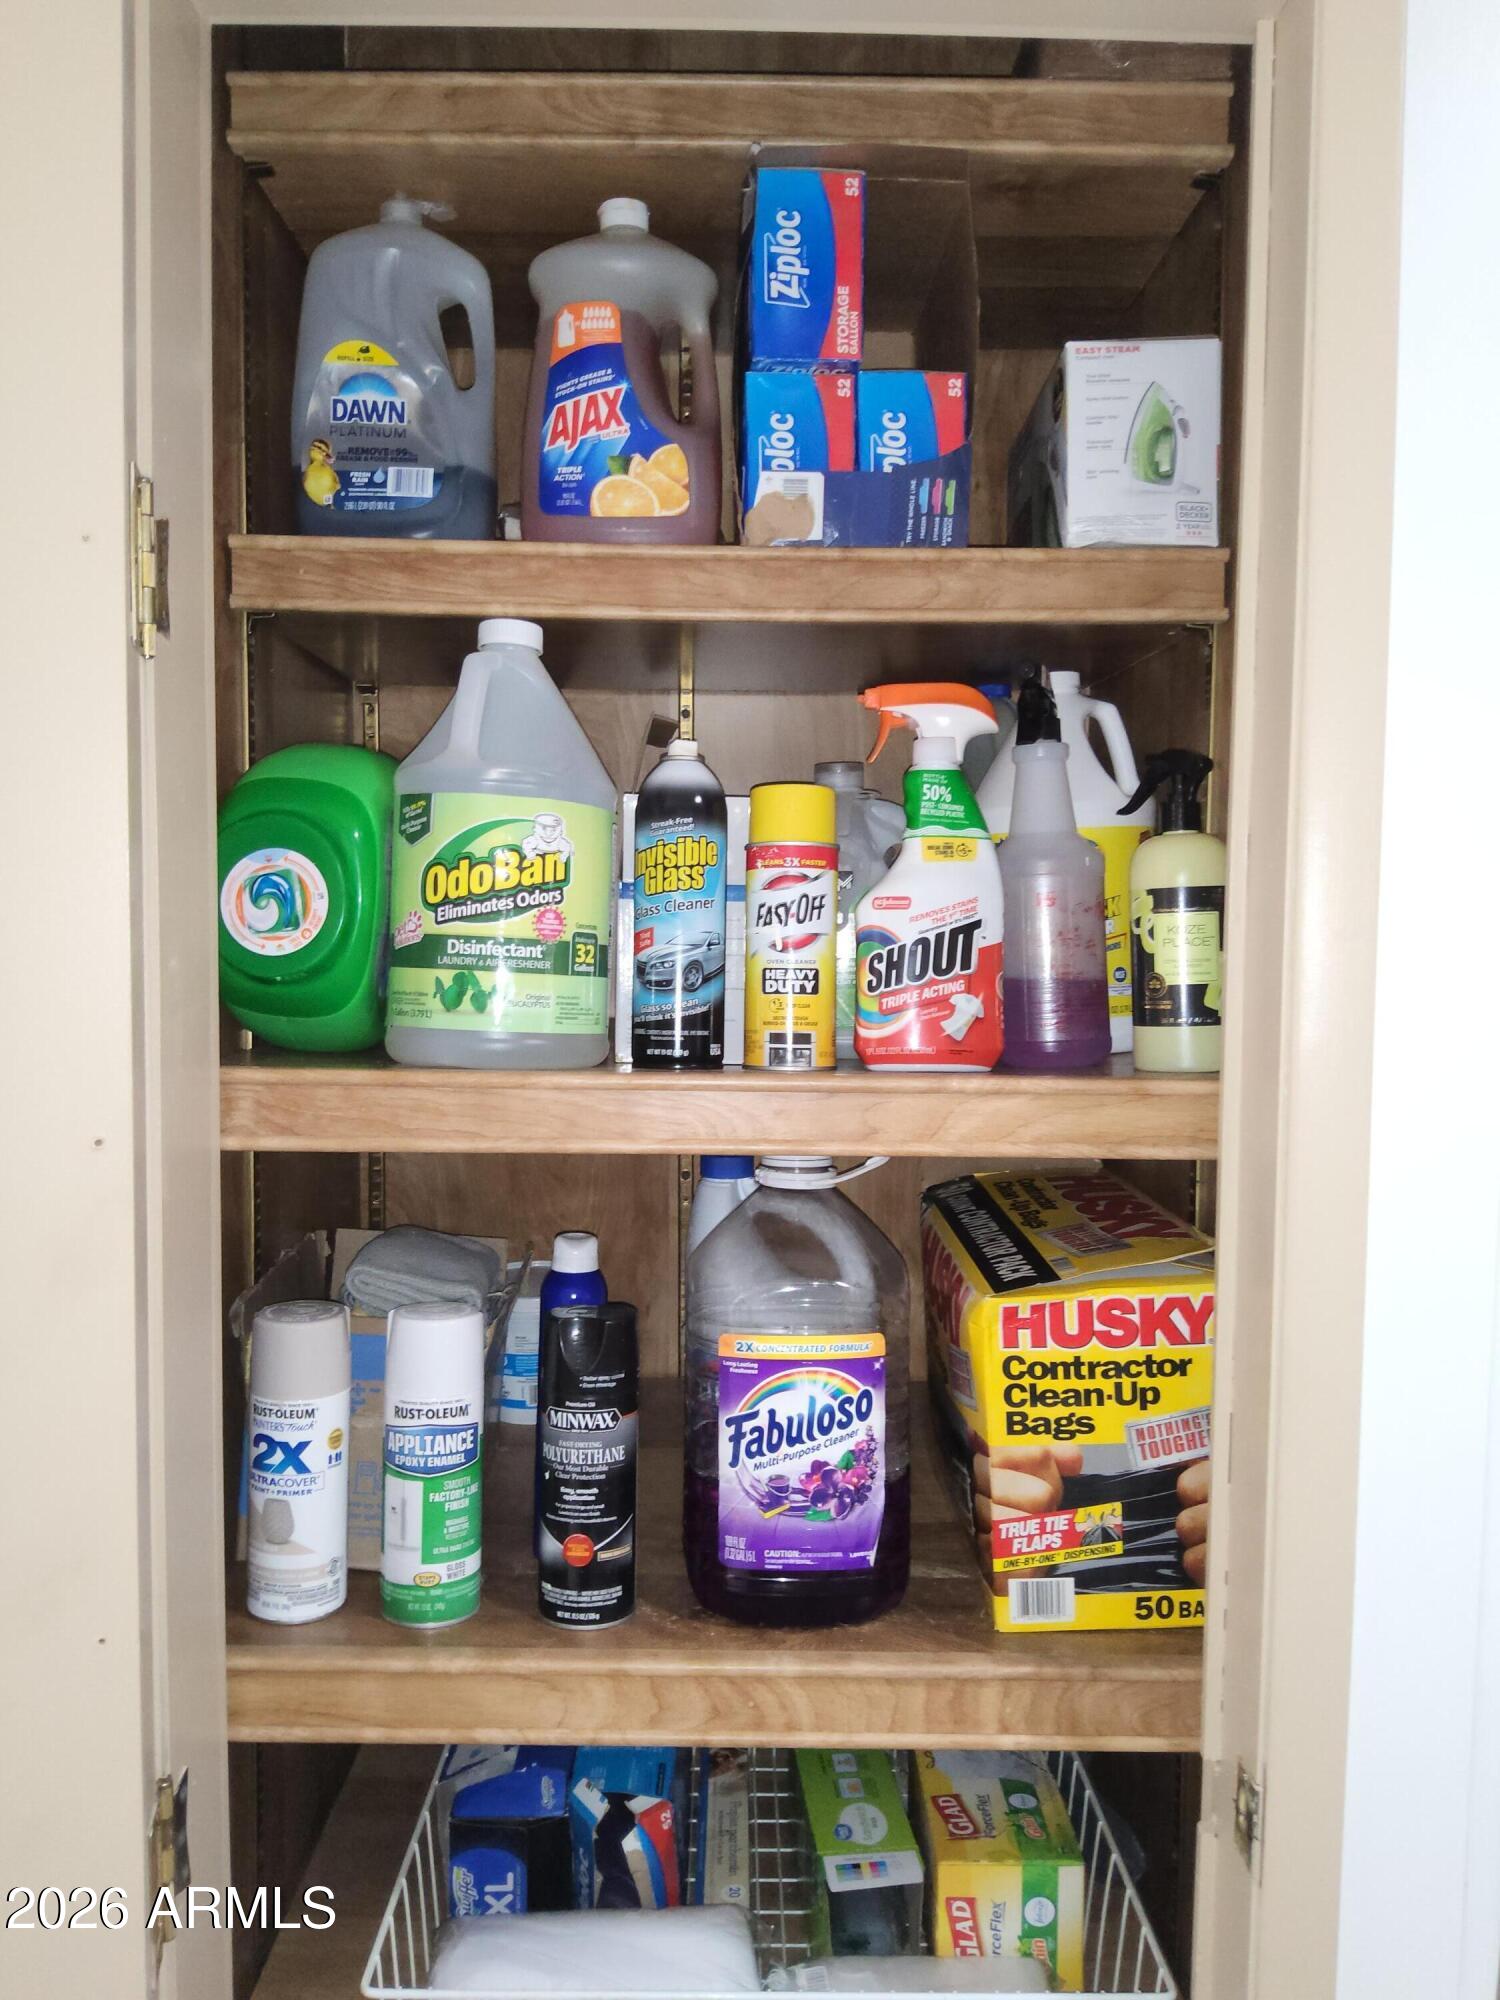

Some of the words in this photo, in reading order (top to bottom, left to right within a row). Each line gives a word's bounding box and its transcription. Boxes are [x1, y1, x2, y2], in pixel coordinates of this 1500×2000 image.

[845, 177, 860, 197] 52
[769, 209, 810, 299] Ziploc
[837, 285, 850, 354] STORAGE
[849, 311, 859, 355] GALLON
[1075, 346, 1102, 355] EASY
[1105, 345, 1141, 354] STEAM
[837, 378, 851, 398] 52
[948, 378, 962, 397] 52
[332, 398, 406, 424] DAWN
[547, 388, 626, 450] AJAX
[329, 426, 407, 439] PLATINUM
[602, 428, 630, 439] ULTRA
[764, 413, 795, 471] ploc
[876, 411, 907, 472] ploc
[557, 465, 582, 474] TRIPLE
[922, 783, 952, 803] 50%
[783, 856, 801, 867] 3X
[425, 848, 566, 905] OdoBan
[644, 864, 705, 896] Glass
[436, 896, 515, 922] Eliminates
[516, 889, 562, 908] Odors
[664, 898, 716, 913] Cleaner
[446, 938, 544, 959] Disinfectant
[575, 943, 595, 964] 32
[867, 918, 983, 994] SHOUT
[437, 955, 477, 966] LAUNDRY
[764, 969, 817, 980] HEAVY
[764, 980, 816, 993] DUTY
[881, 990, 921, 1010] TRIPLE
[921, 980, 966, 1000] ACTING
[957, 1210, 1019, 1259] CONTRACTOR
[989, 1254, 1038, 1282] PACK
[1001, 1295, 1215, 1350] HUSKY
[735, 1341, 754, 1353] 2X
[756, 1344, 826, 1353] CONCENTRATED
[828, 1342, 870, 1353] FORMULA
[1002, 1353, 1193, 1381] Contractor
[253, 1403, 316, 1420] RUST-OLEUM
[394, 1404, 470, 1420] RUST-OLEUM
[549, 1409, 614, 1430] MINWAX
[724, 1388, 874, 1469] Fabuloso
[1005, 1411, 1096, 1441] Bags
[387, 1428, 475, 1456] APPLIANCE
[752, 1442, 822, 1472] Multi-Purpose
[823, 1427, 861, 1449] Cleaner
[1137, 1430, 1209, 1461] TOUGHE
[252, 1433, 313, 1475] 2X
[394, 1454, 426, 1467] EPOXY
[427, 1453, 467, 1468] ENAMEL
[543, 1442, 626, 1465] POLYURETHANE
[442, 1476, 471, 1491] SMOOTH
[571, 1472, 607, 1481] Protection
[276, 1488, 313, 1497] PRIMER
[998, 1521, 1044, 1539] TRUE
[1045, 1514, 1074, 1532] TIE
[763, 1549, 801, 1558] CAUTION:
[1012, 1532, 1063, 1554] FLAPS
[446, 1560, 467, 1572] GLOSS
[1002, 1554, 1057, 1569] ONE-BY-ONE
[1063, 1545, 1117, 1561] DISPENSING
[446, 1569, 467, 1580] WHITE
[1134, 1595, 1174, 1620] 50
[1179, 1601, 1204, 1619] BA
[661, 1809, 673, 1830] 52
[938, 1796, 977, 1835] GLAD
[484, 1871, 515, 1916] XL
[951, 1900, 981, 1958] GLAD
[989, 1899, 1004, 1956] rceFlex
[1032, 1938, 1046, 1958] ain
